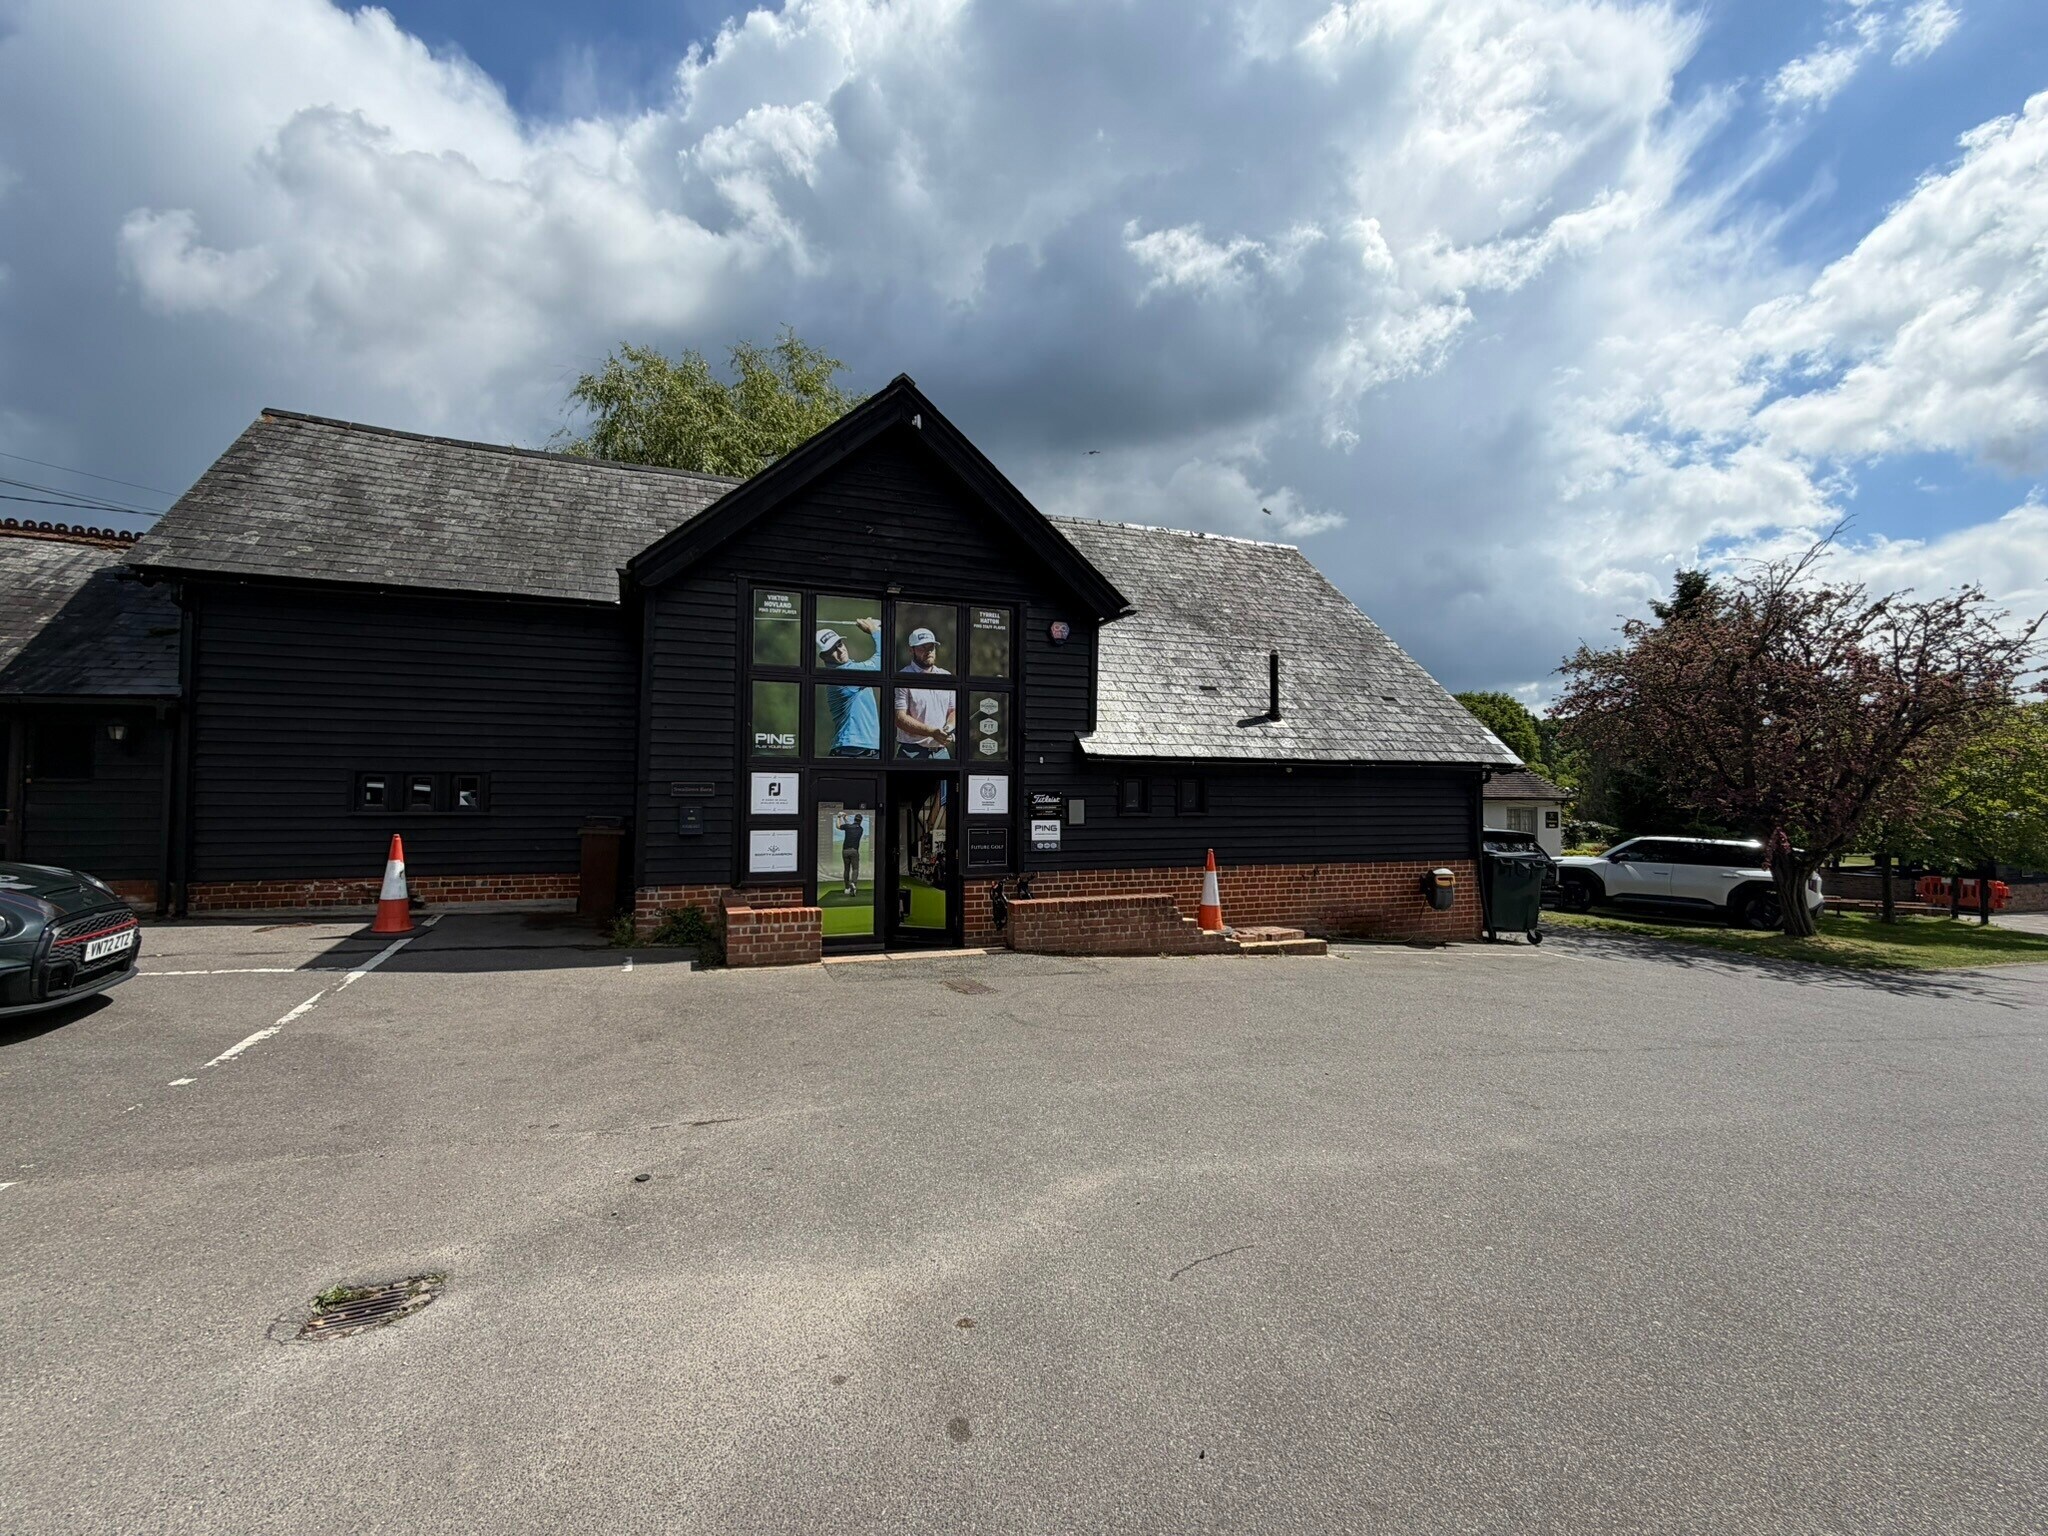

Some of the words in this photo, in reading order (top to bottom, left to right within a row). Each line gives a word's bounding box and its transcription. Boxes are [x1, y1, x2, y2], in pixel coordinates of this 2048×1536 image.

[755, 733, 796, 744] PING
[768, 782, 781, 796] FJ
[1031, 794, 1061, 804] Titleist
[1034, 824, 1058, 832] PING
[114, 932, 131, 949] ZTZ
